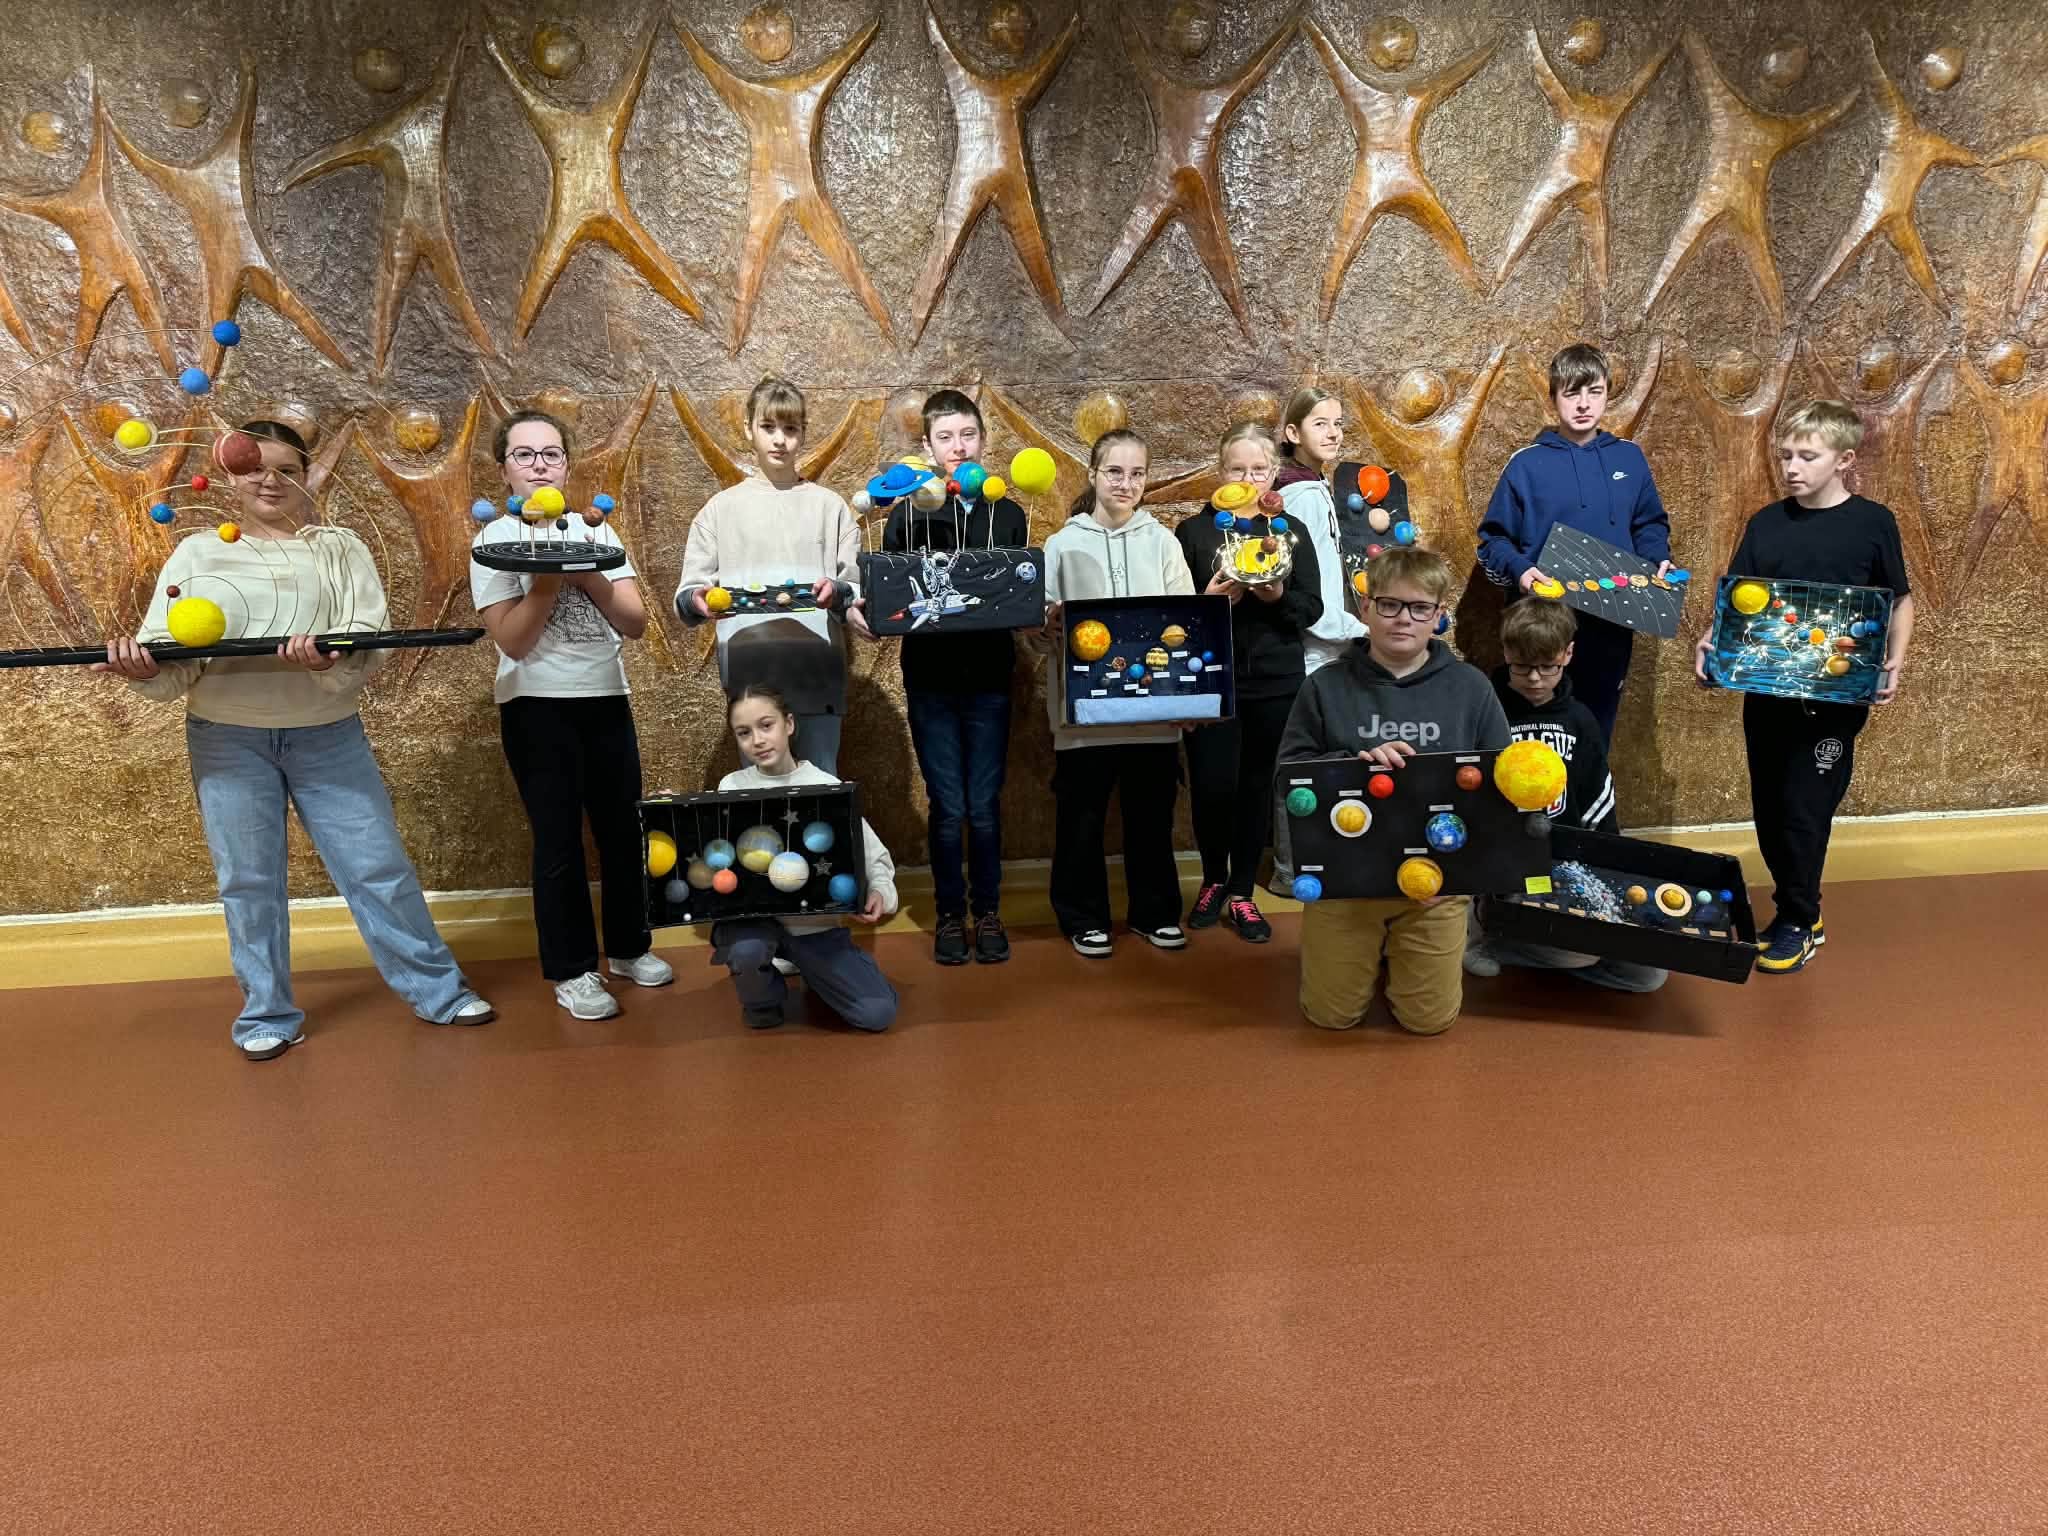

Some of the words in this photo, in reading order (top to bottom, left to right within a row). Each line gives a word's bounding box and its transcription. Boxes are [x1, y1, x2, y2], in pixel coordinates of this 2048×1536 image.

[1357, 714, 1440, 746] Jeep
[1510, 723, 1538, 733] NATIONAL
[1511, 731, 1577, 761] GUE
